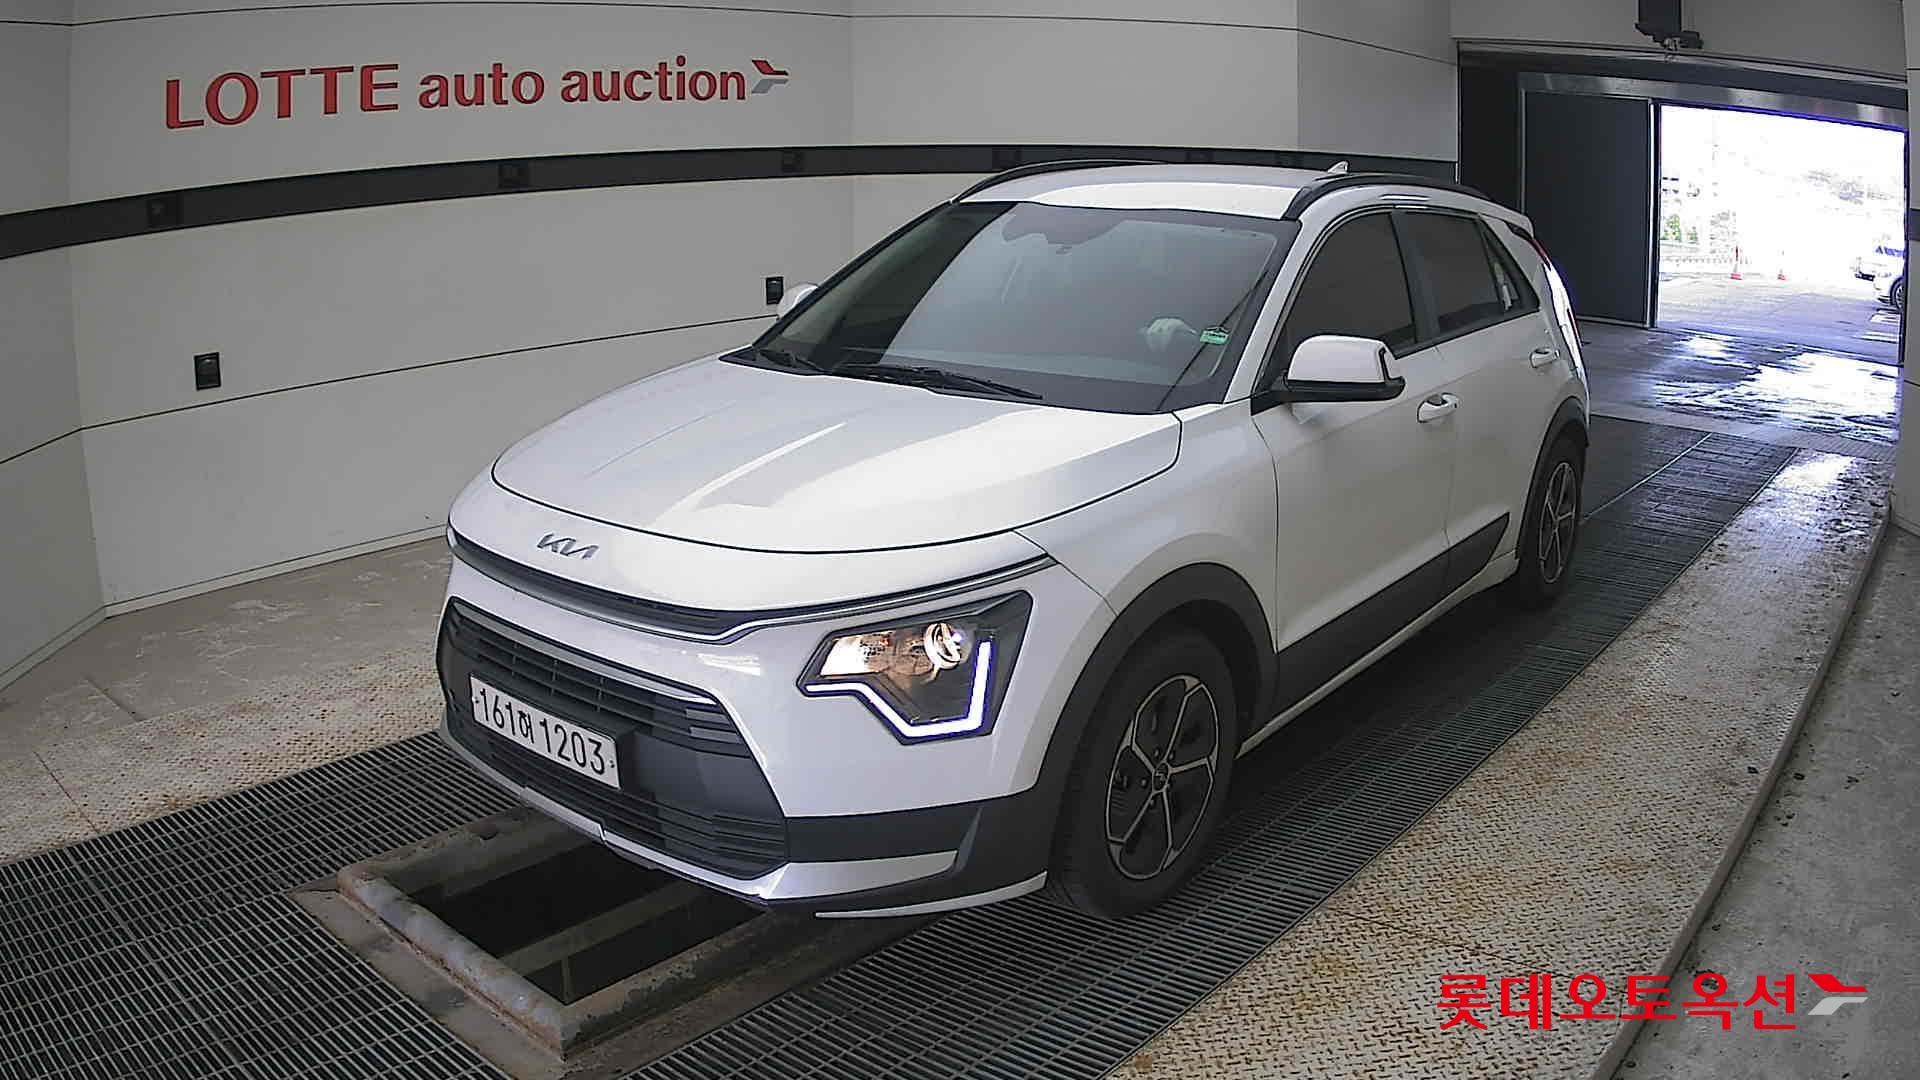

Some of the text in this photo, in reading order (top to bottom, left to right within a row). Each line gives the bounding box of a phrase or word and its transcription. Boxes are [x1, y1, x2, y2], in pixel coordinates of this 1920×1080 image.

[165, 55, 747, 130] LOTTE auto auction
[536, 533, 599, 559] KIA
[540, 718, 605, 775] 1203
